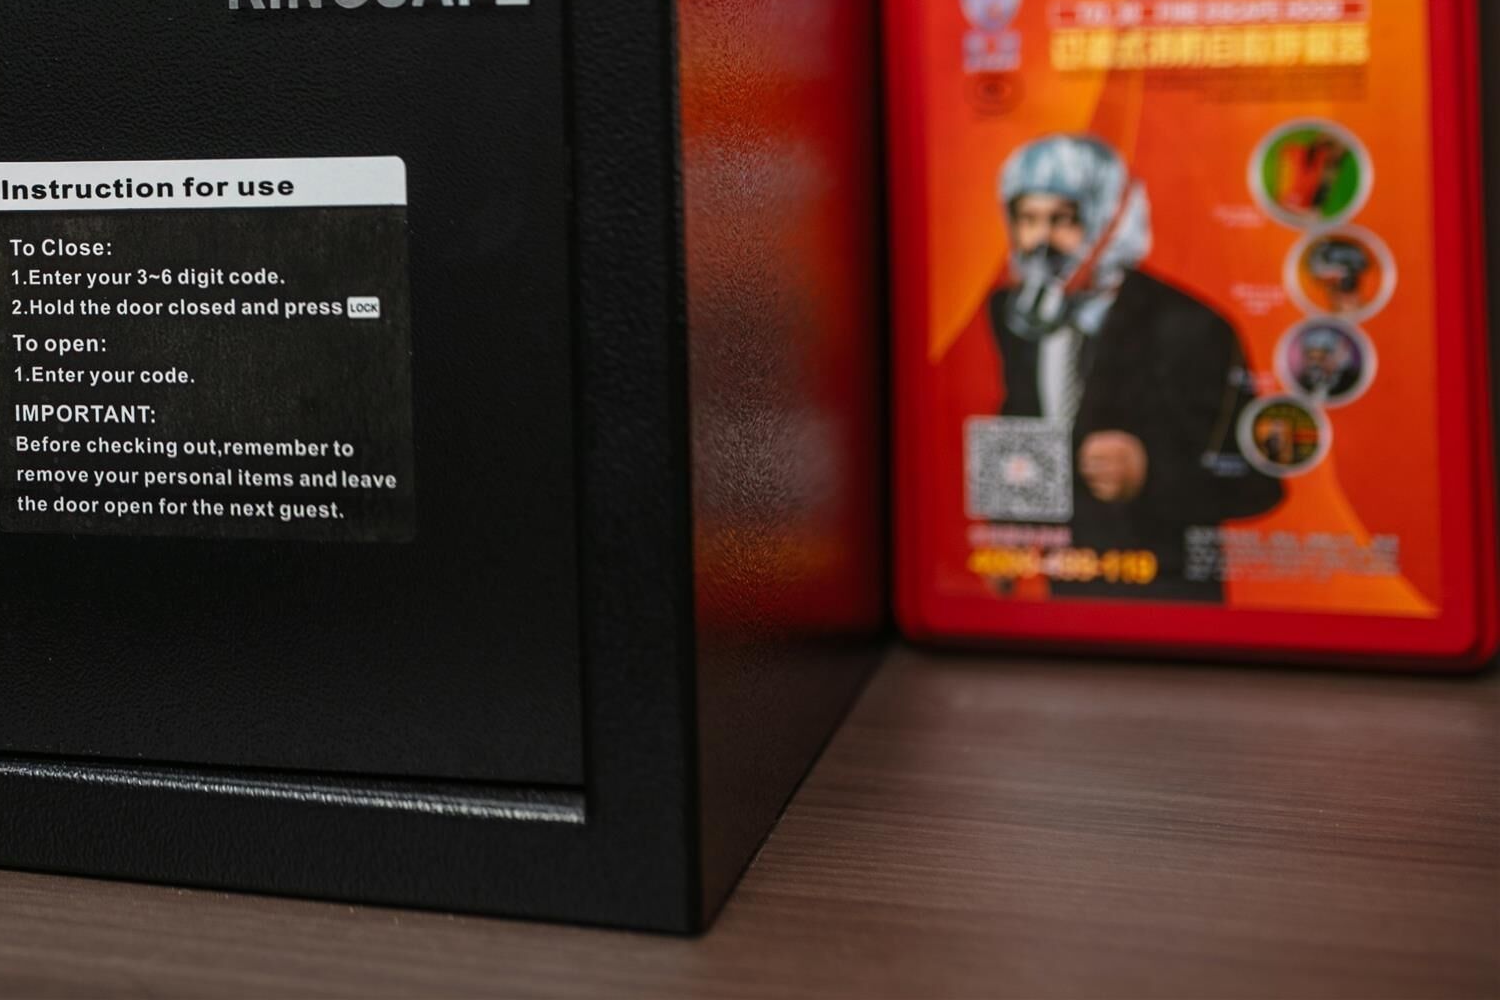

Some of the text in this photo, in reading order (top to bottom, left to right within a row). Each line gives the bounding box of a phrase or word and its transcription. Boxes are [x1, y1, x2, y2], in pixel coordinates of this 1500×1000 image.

[1, 176, 294, 200] Instruction for use
[10, 239, 111, 256] To Close:
[11, 267, 285, 289] 1.Enter your 3~6 digit code.
[11, 298, 378, 319] 2.Hold the door closed and press LOCK
[13, 334, 106, 355] To open:
[14, 366, 195, 387] 1.Enter your code.
[15, 404, 156, 424] IMPORTANT:
[16, 435, 354, 458] Before checking out,remember to
[16, 468, 397, 489] remove your personal items and leave
[17, 495, 344, 522] the door open for the next guest.
